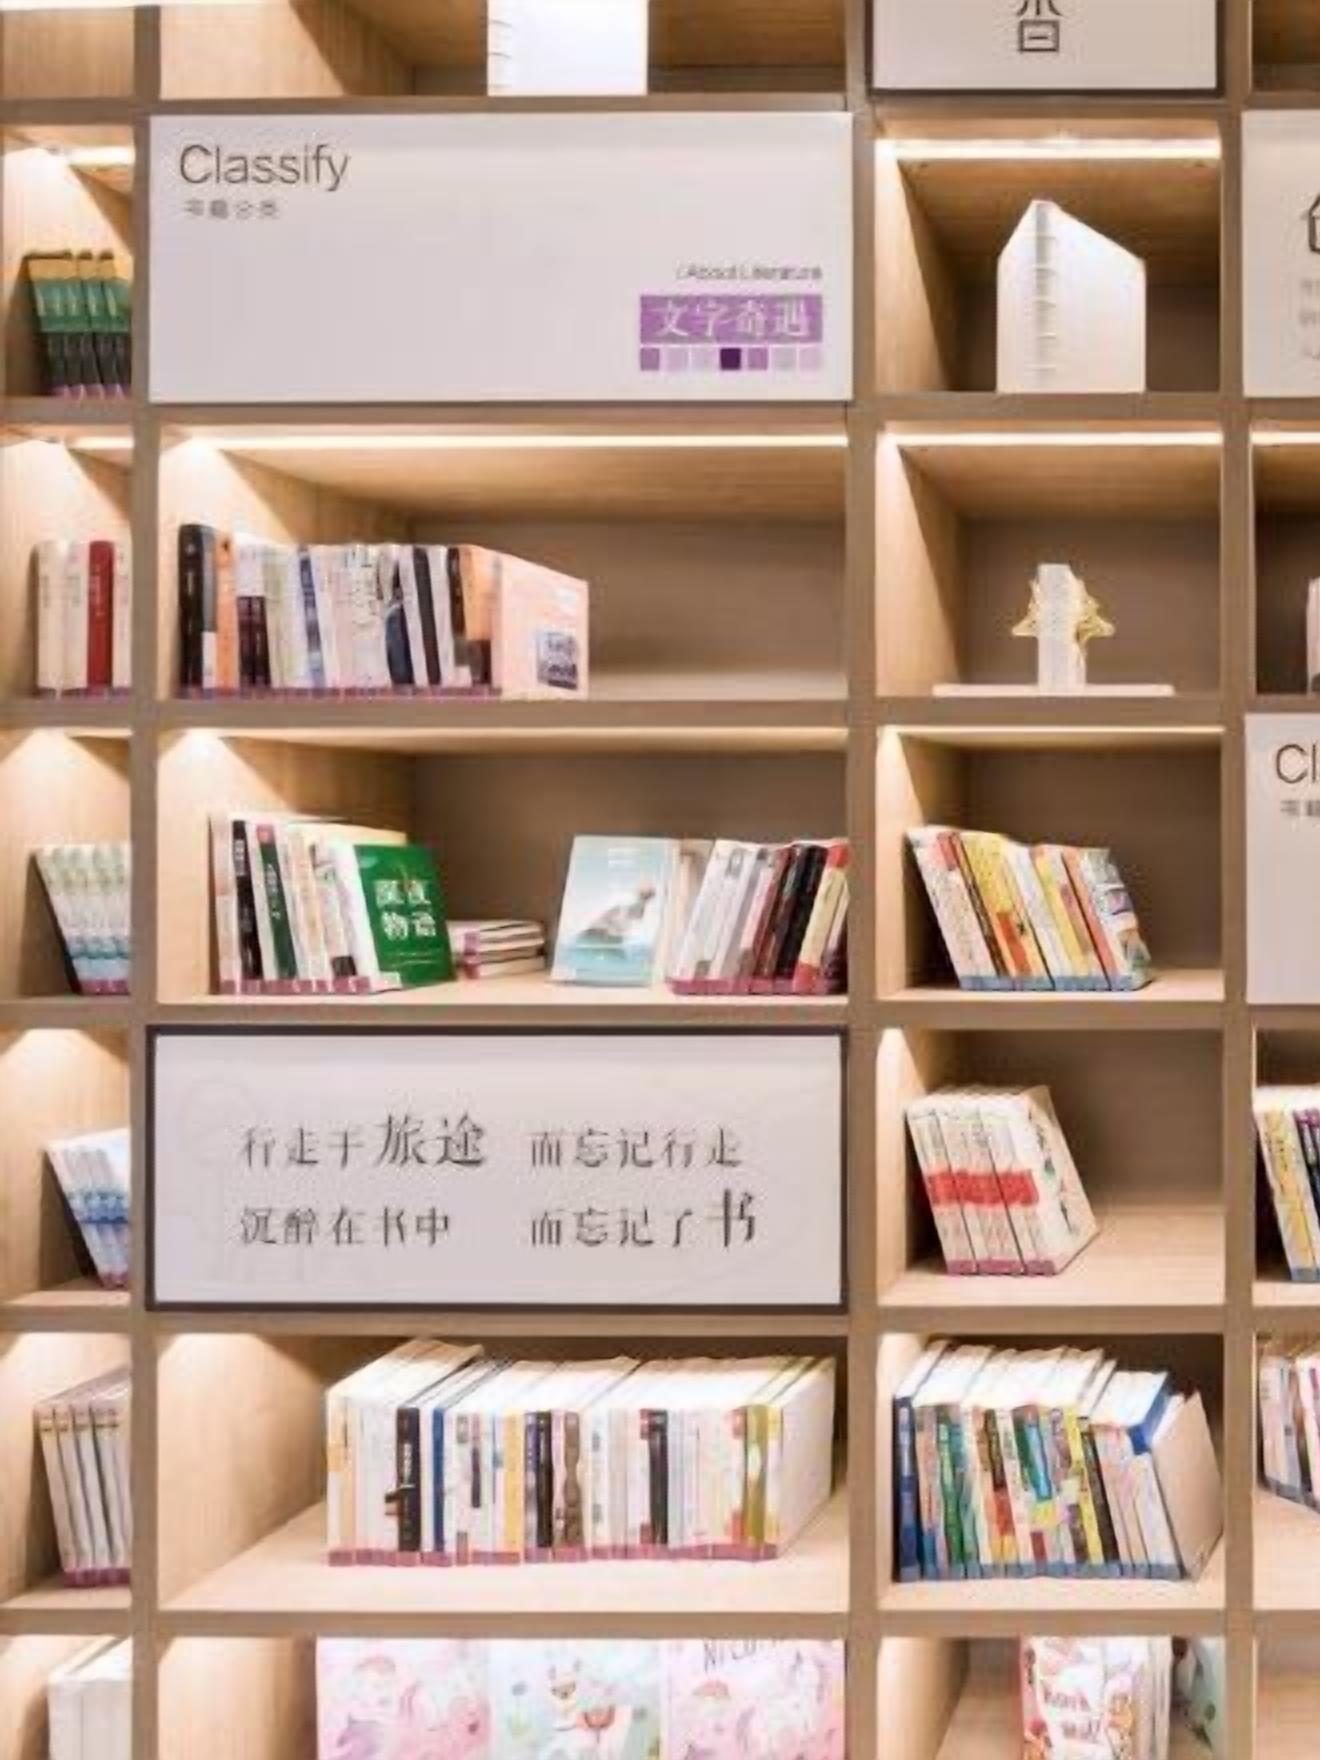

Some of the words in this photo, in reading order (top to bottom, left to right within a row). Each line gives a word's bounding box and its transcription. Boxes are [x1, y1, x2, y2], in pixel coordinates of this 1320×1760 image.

[180, 143, 351, 192] Classify
[528, 1127, 743, 1169] 而忘记行走
[240, 1205, 450, 1248] 沉醉在书中
[528, 1188, 757, 1250] 而忘记了书
